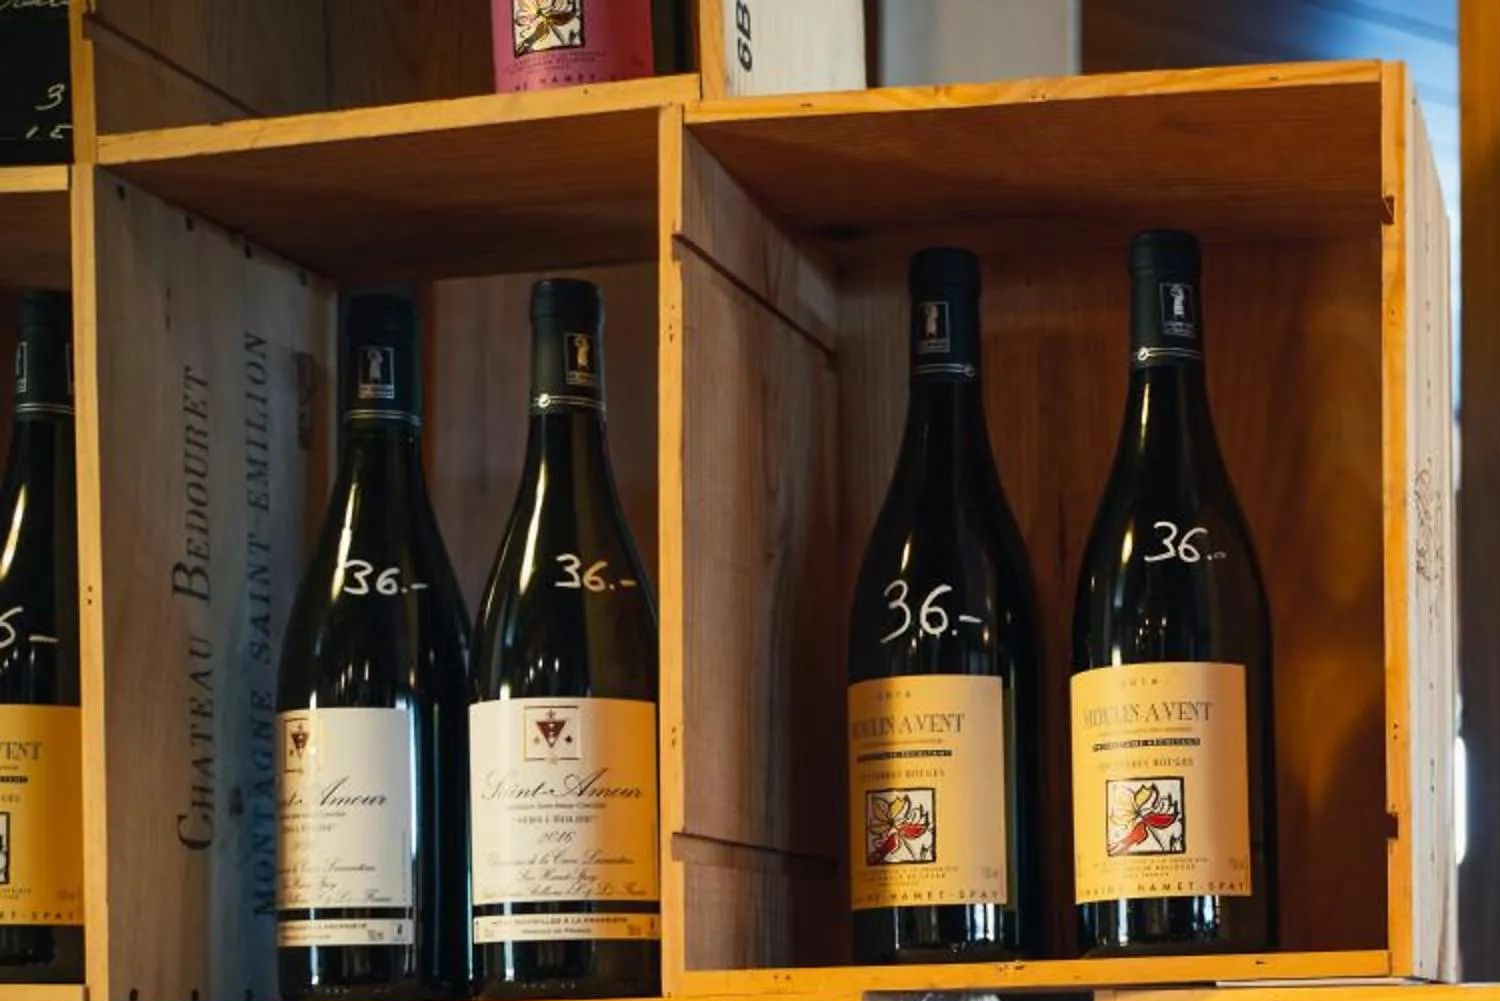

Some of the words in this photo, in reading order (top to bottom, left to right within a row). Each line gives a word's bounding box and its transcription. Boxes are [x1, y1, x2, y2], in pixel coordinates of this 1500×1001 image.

[171, 365, 213, 606] BEDOURET
[880, 579, 984, 644] 36.-
[177, 634, 214, 851] CHATEAU
[247, 689, 276, 918] MONTAGNE
